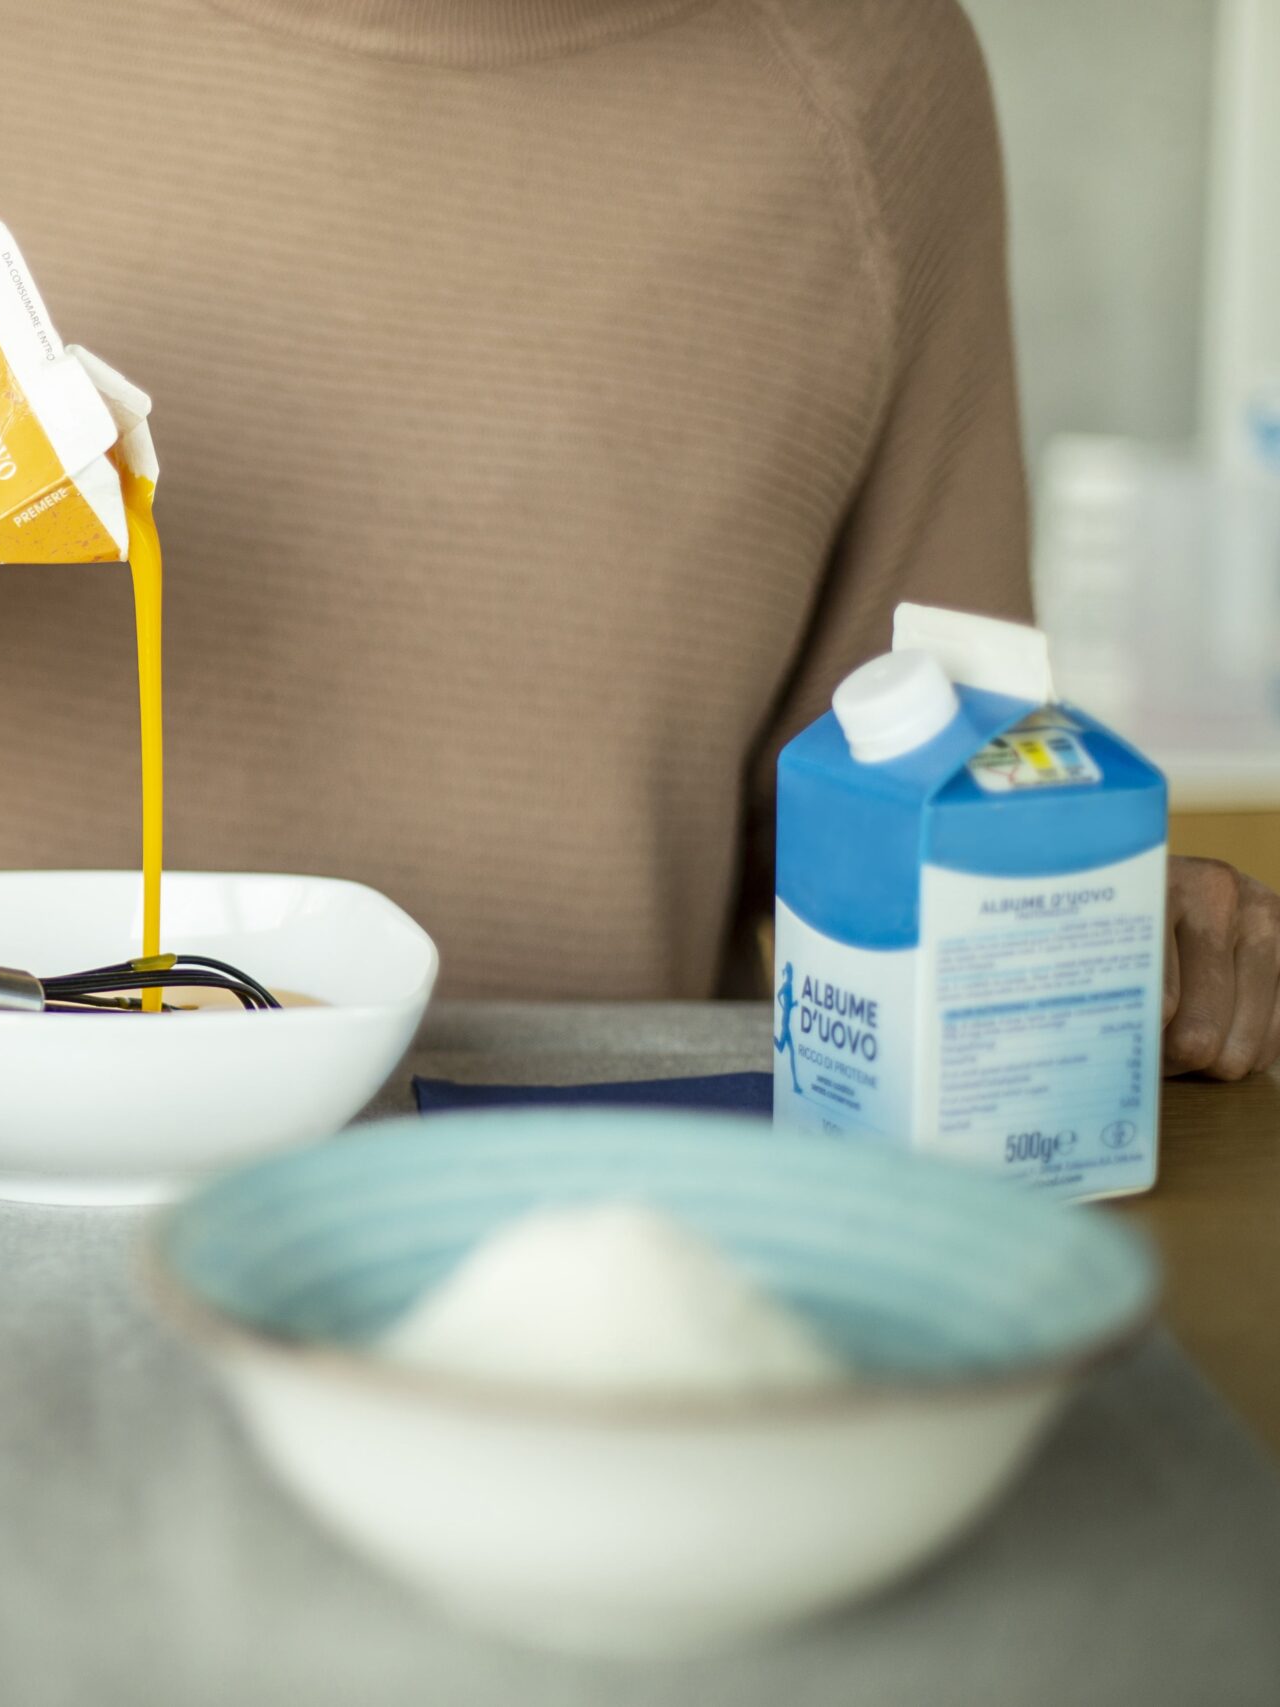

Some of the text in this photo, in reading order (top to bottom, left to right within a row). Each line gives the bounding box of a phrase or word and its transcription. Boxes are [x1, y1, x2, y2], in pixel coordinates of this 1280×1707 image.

[1, 251, 56, 362] DA CONSUMARE ENTRO
[12, 487, 68, 528] PREMERE
[979, 895, 1046, 915] ALBUME
[1051, 887, 1116, 908] D'UOVO
[801, 974, 878, 1029] ALBUME
[800, 1005, 878, 1062] D'UOVO
